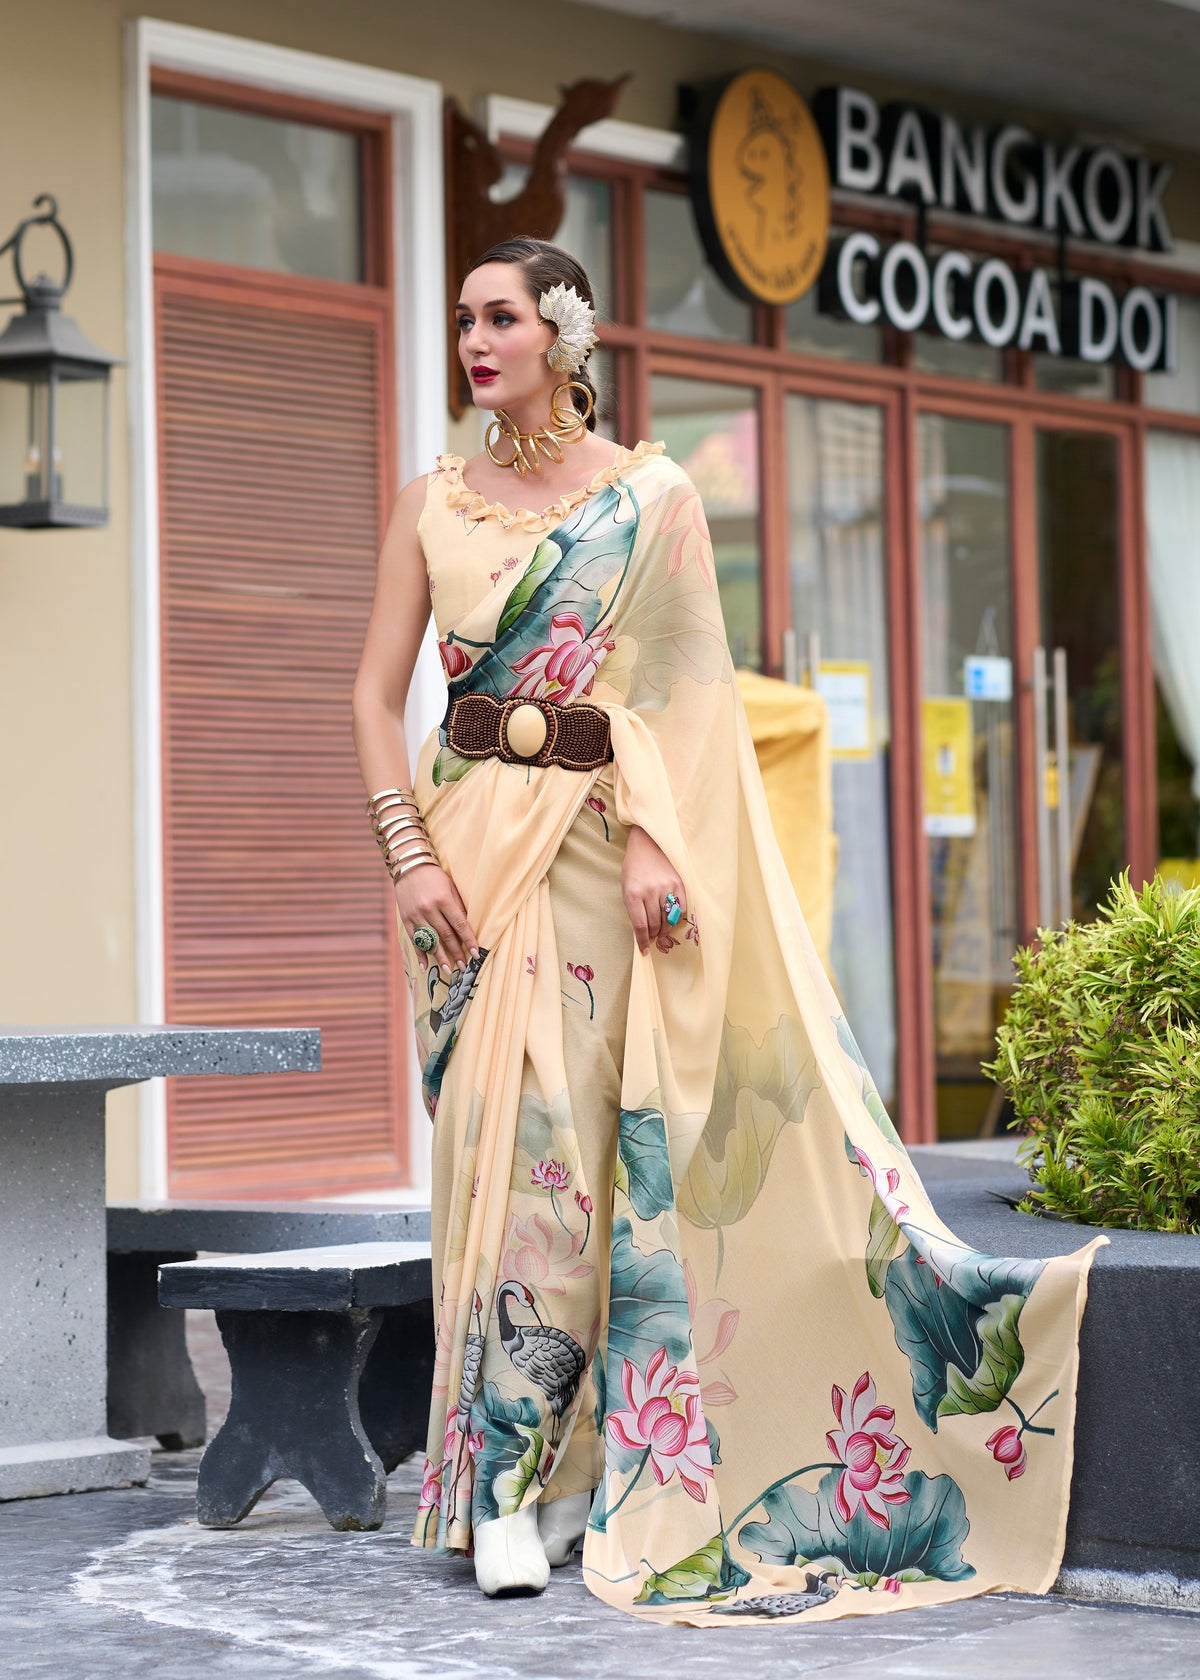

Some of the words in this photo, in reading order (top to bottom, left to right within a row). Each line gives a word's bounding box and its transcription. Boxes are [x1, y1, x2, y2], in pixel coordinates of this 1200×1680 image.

[837, 86, 1174, 251] BANGKOK
[838, 232, 1061, 355] COCOA
[1079, 277, 1178, 375] DOI
